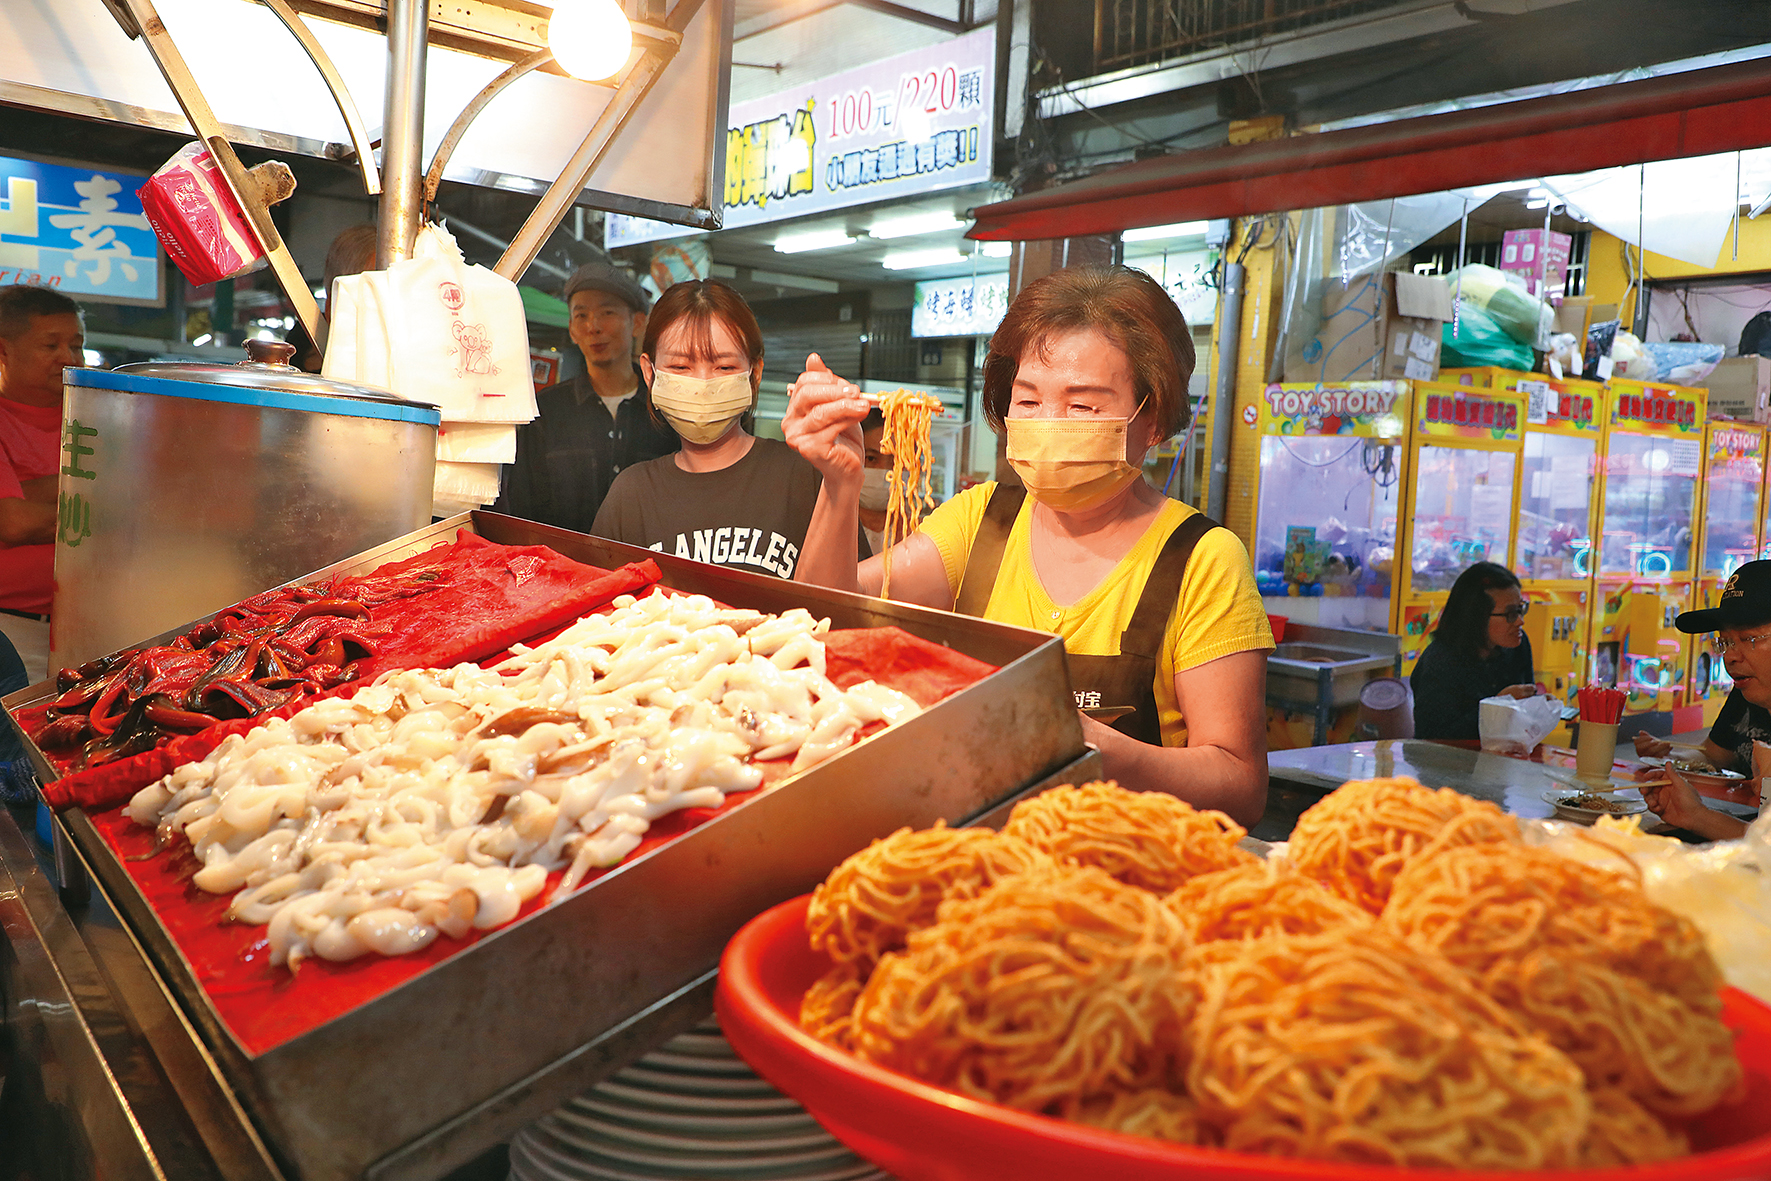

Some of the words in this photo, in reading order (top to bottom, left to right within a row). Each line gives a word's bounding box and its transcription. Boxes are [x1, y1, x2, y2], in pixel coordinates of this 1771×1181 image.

[1269, 390, 1316, 417] TOY
[1319, 388, 1398, 417] STORY
[1713, 430, 1733, 448] TOY
[674, 527, 798, 580] ANGELES
